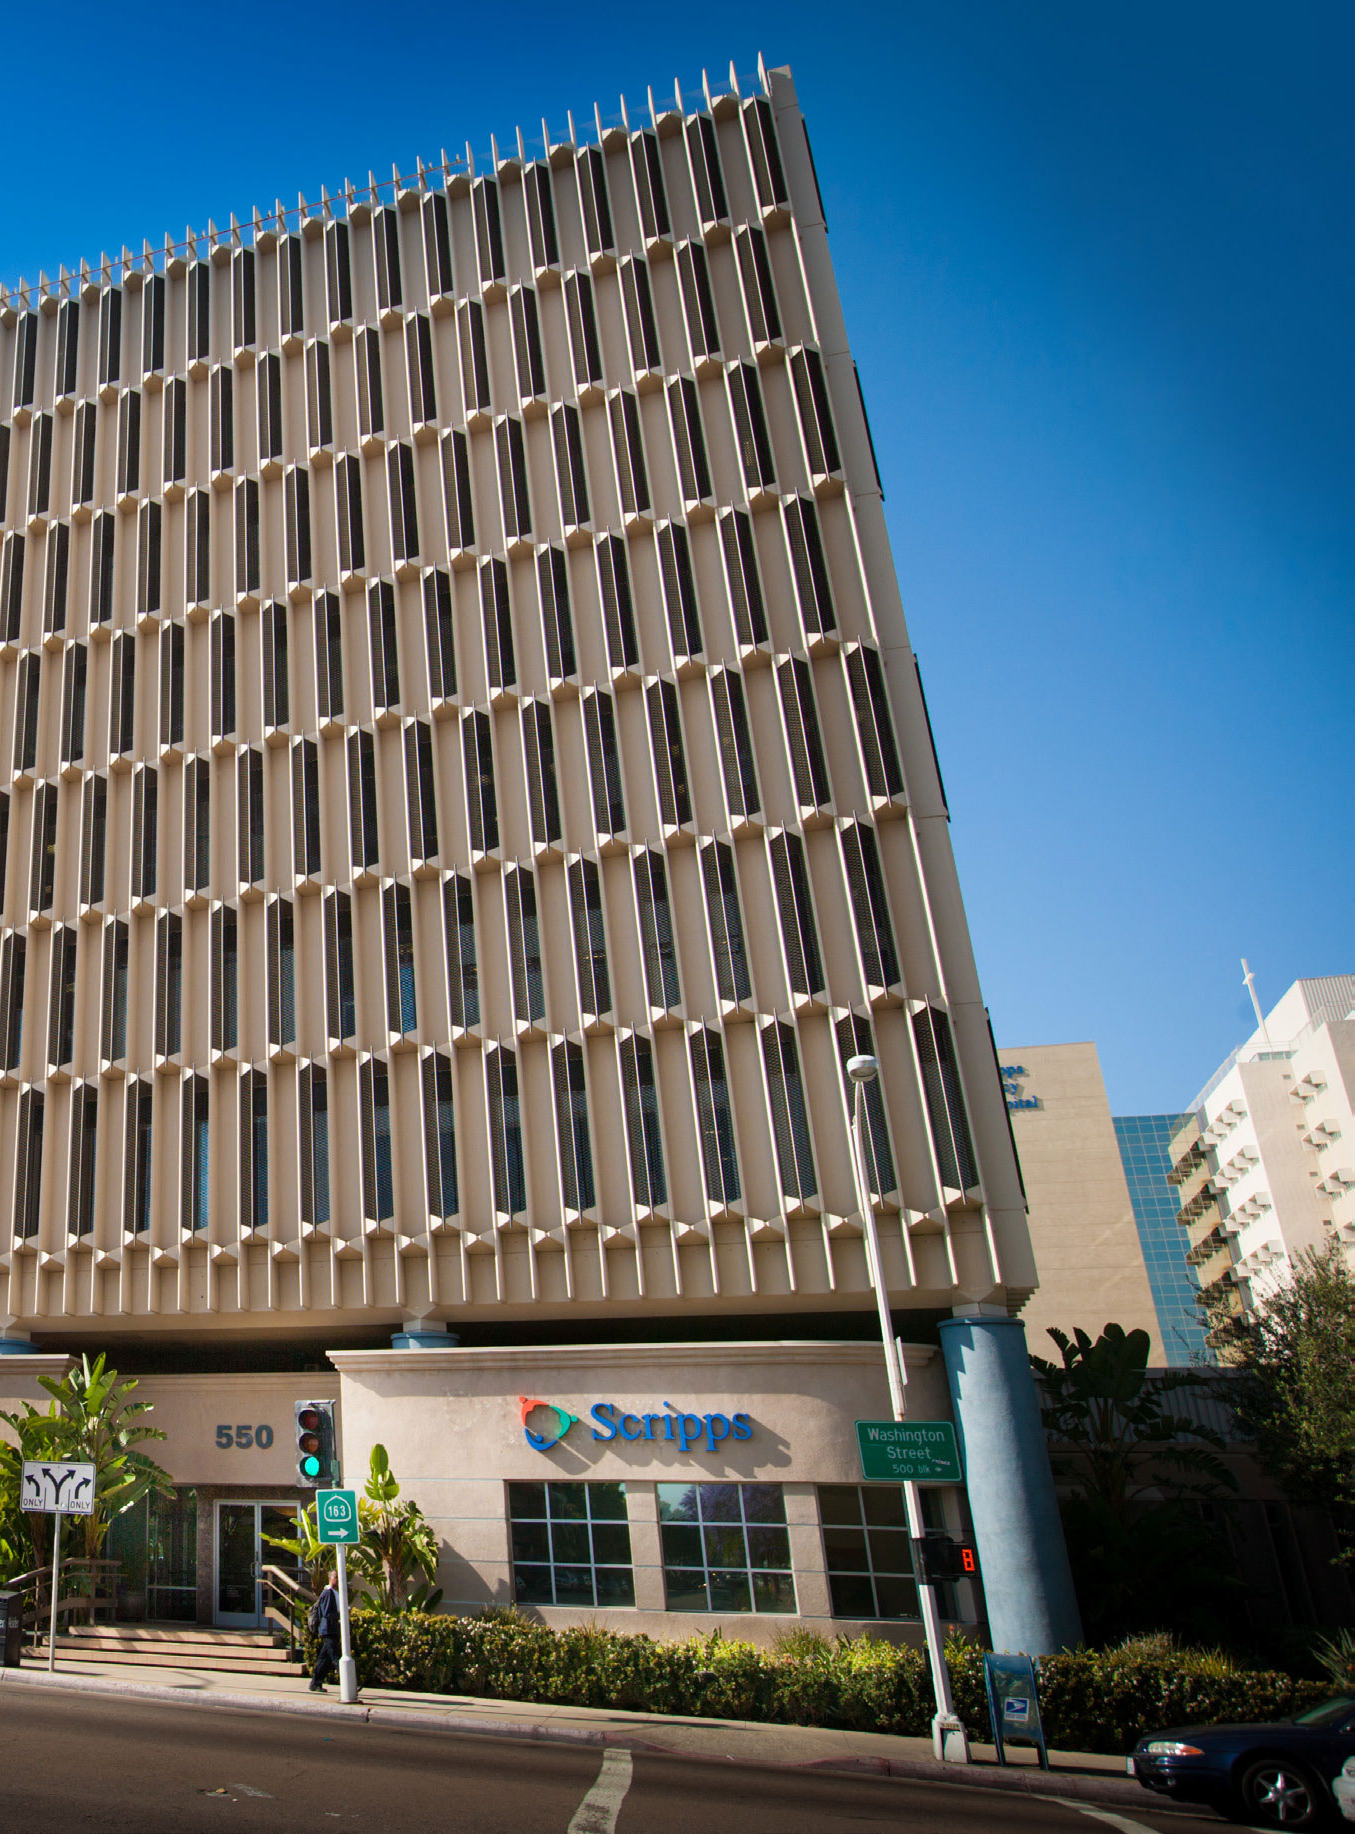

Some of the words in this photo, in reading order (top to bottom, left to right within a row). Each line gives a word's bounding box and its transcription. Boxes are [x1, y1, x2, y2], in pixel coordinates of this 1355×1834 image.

[590, 1401, 753, 1451] Scripps
[215, 1425, 274, 1449] 550
[867, 1428, 945, 1445] Washington
[887, 1446, 932, 1459] Street
[892, 1464, 914, 1473] 500
[918, 1464, 930, 1473] blk
[70, 1501, 90, 1509] ONLY
[327, 1505, 346, 1517] 163
[962, 1549, 975, 1571] 8
